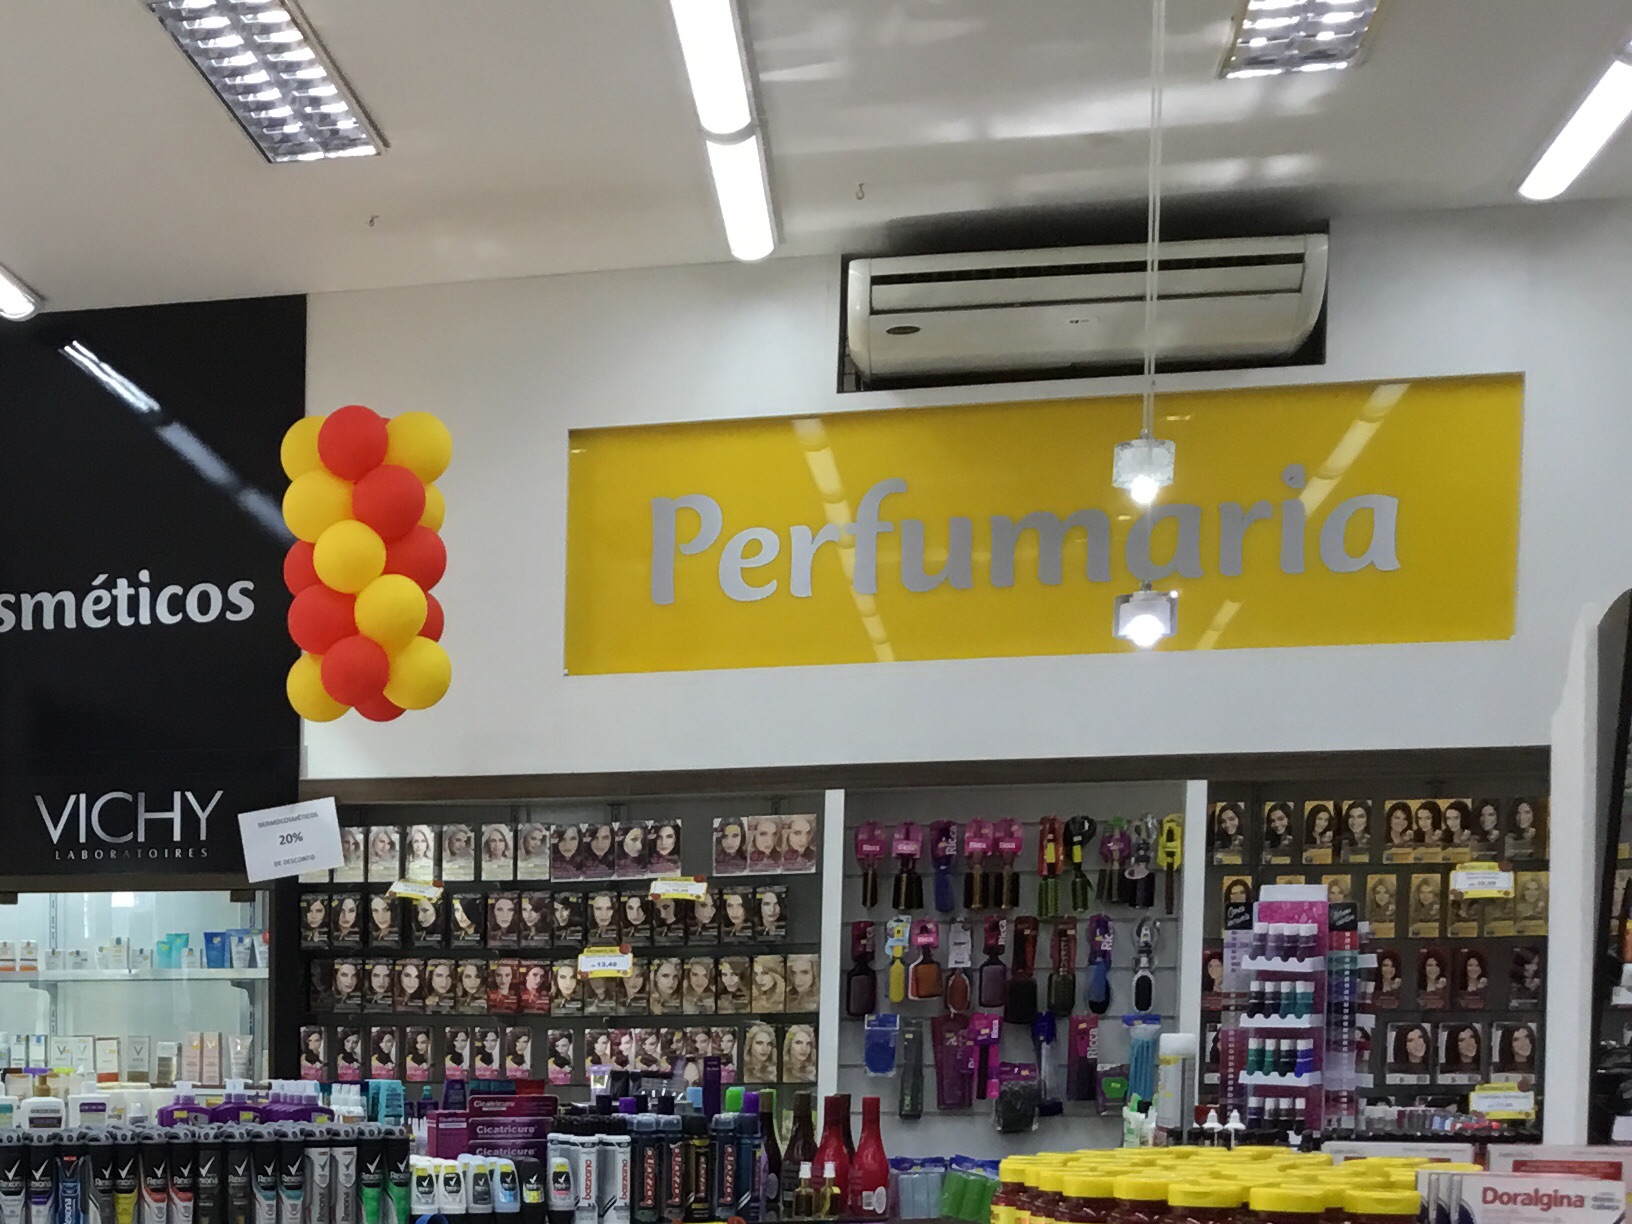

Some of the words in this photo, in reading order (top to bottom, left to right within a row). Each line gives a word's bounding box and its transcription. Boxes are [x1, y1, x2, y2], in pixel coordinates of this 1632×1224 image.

[650, 462, 1400, 604] Perfumaria
[35, 789, 224, 845] VICHY
[279, 832, 304, 846] 20%
[54, 846, 210, 861] LABORATOIRES
[476, 1125, 535, 1134] Cicatricure
[1481, 1185, 1585, 1211] Doralgina
